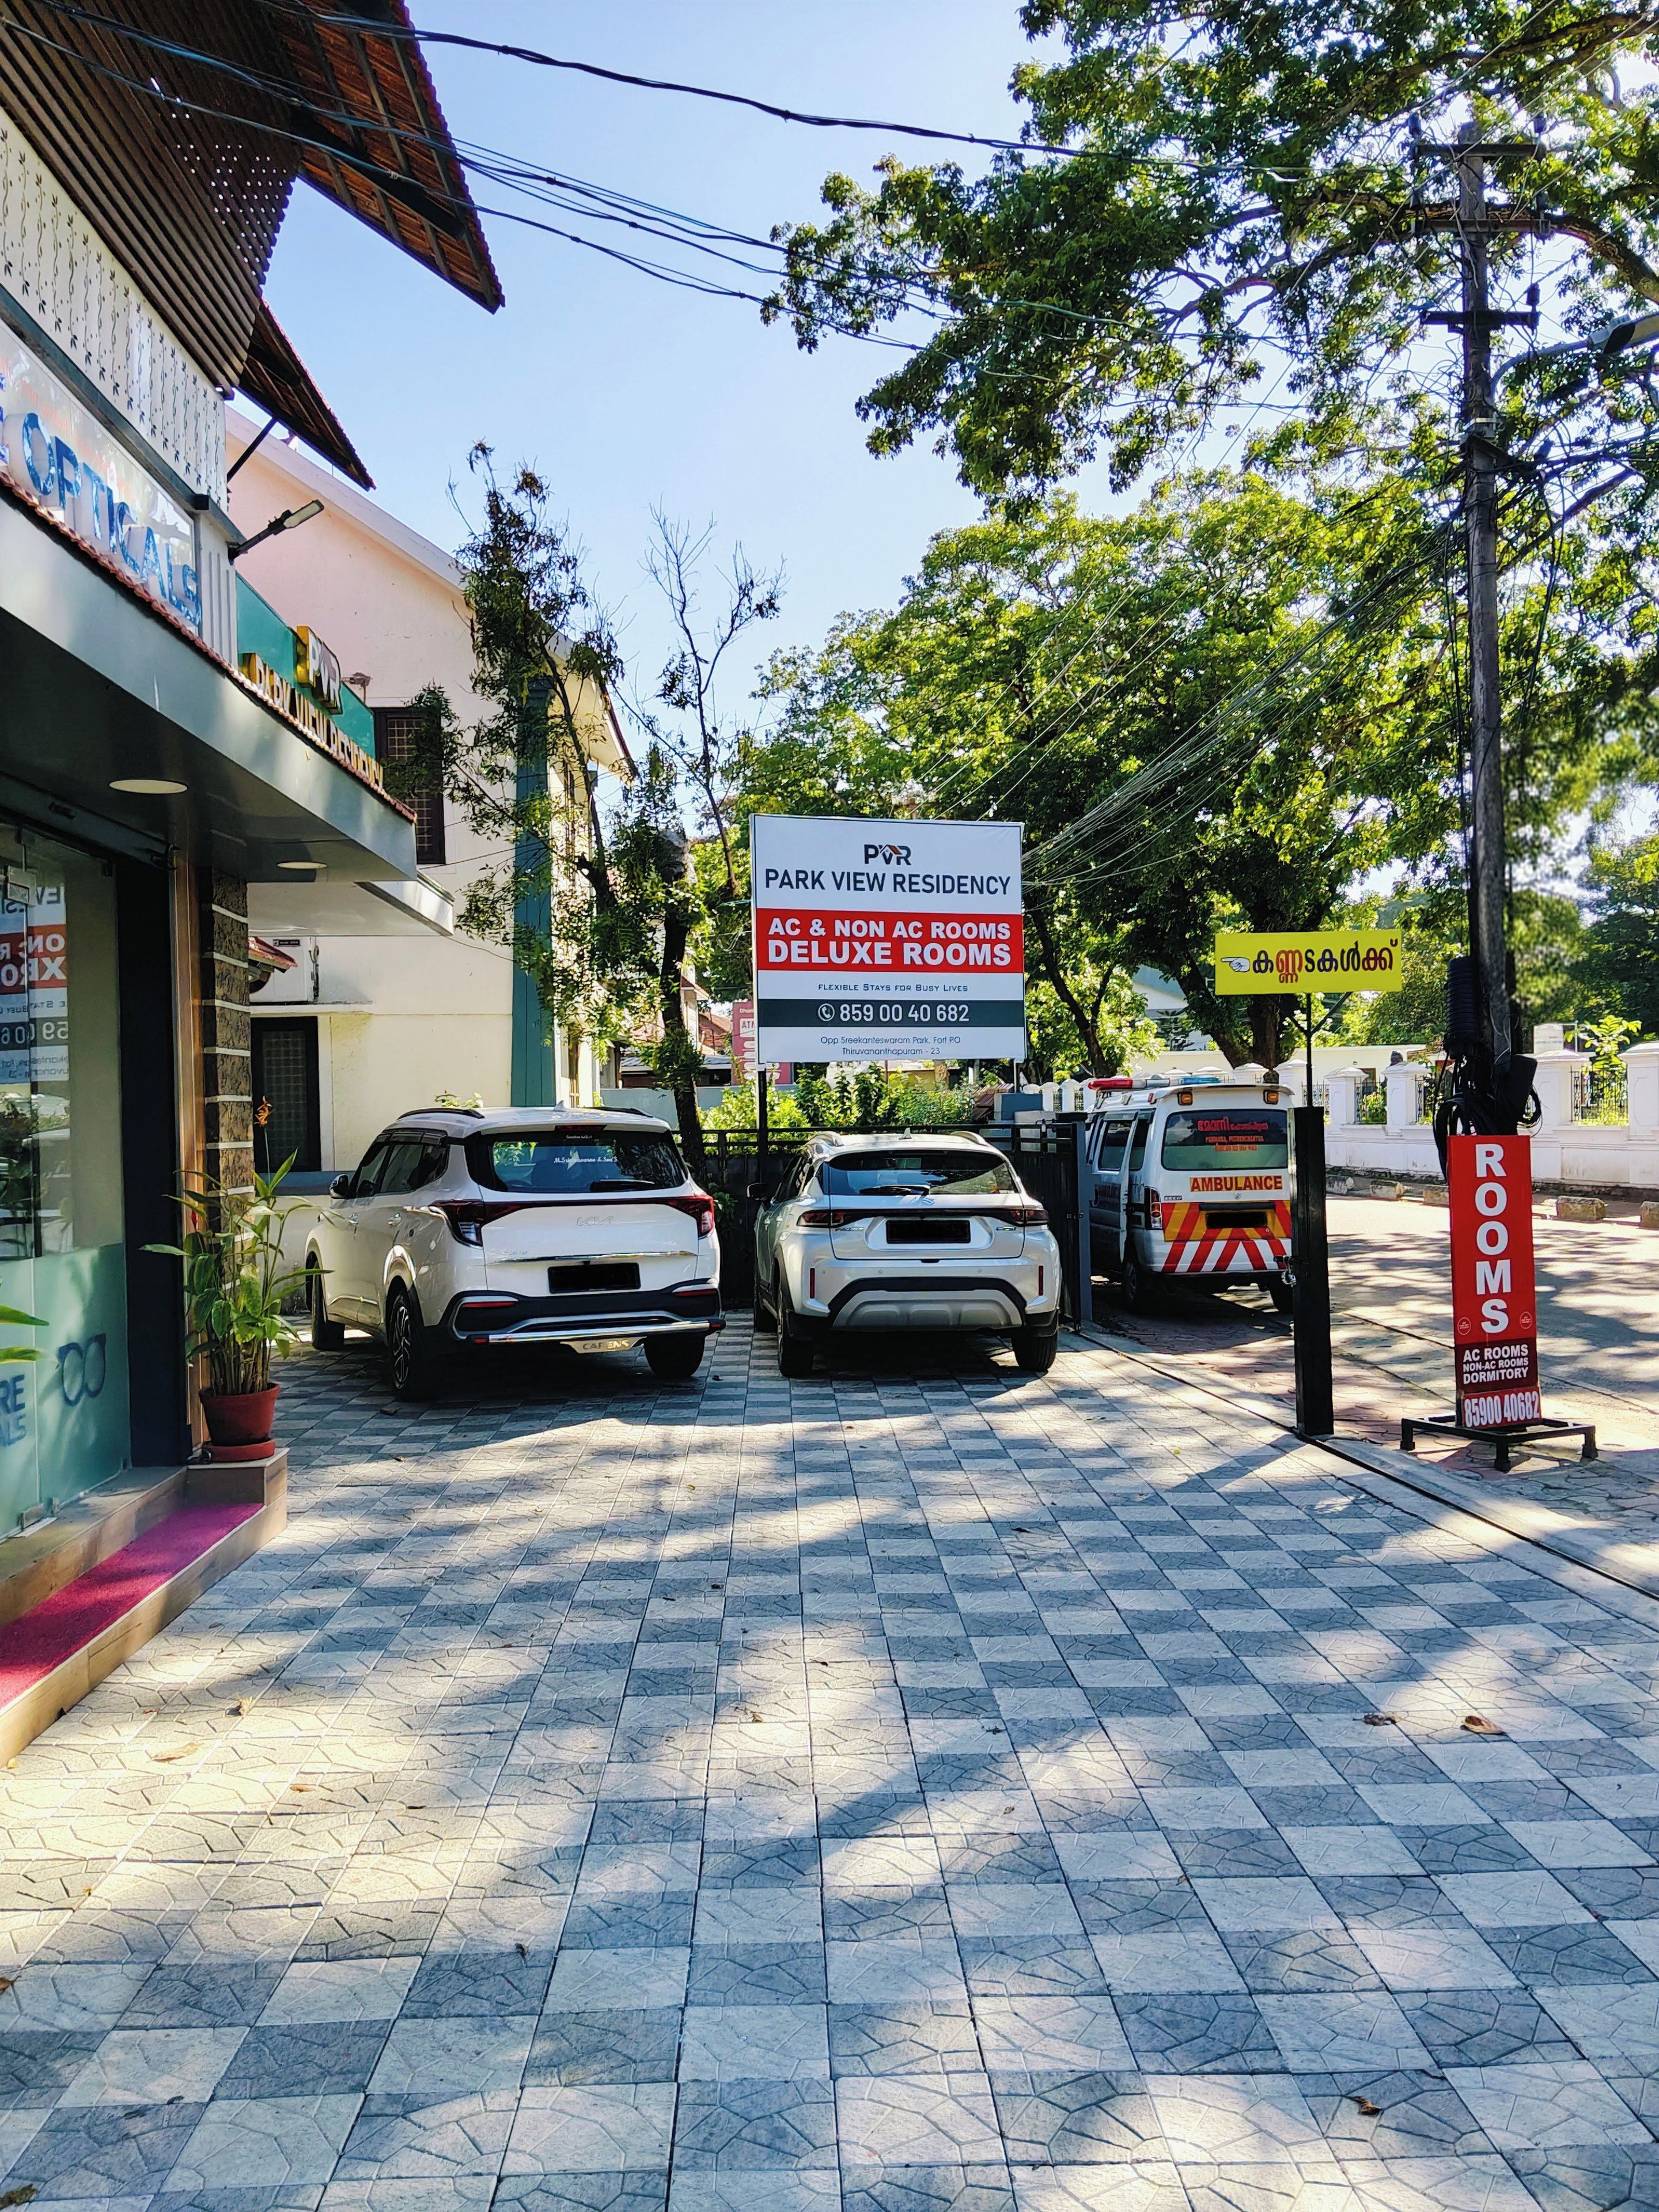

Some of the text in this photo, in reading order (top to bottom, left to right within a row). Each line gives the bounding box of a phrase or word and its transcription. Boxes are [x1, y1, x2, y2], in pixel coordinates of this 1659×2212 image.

[864, 844, 912, 866] PVR
[765, 868, 1011, 895] PARK VIEW RESIDENCY
[768, 918, 1011, 940] AC & NON AC ROOMS
[768, 940, 1012, 966] DELUXE ROOMS
[840, 1004, 969, 1022] 859 00 40 682
[842, 1047, 923, 1056] Thiruvananthapuram
[1190, 1175, 1283, 1192] AMBULANCE
[1474, 1143, 1512, 1335] ROOMS
[1463, 1344, 1529, 1363] AC ROOMS
[1463, 1357, 1529, 1373] NON-AC ROOMS
[1463, 1367, 1529, 1385] DORMITORY
[1464, 1391, 1540, 1427] 85900 40682
